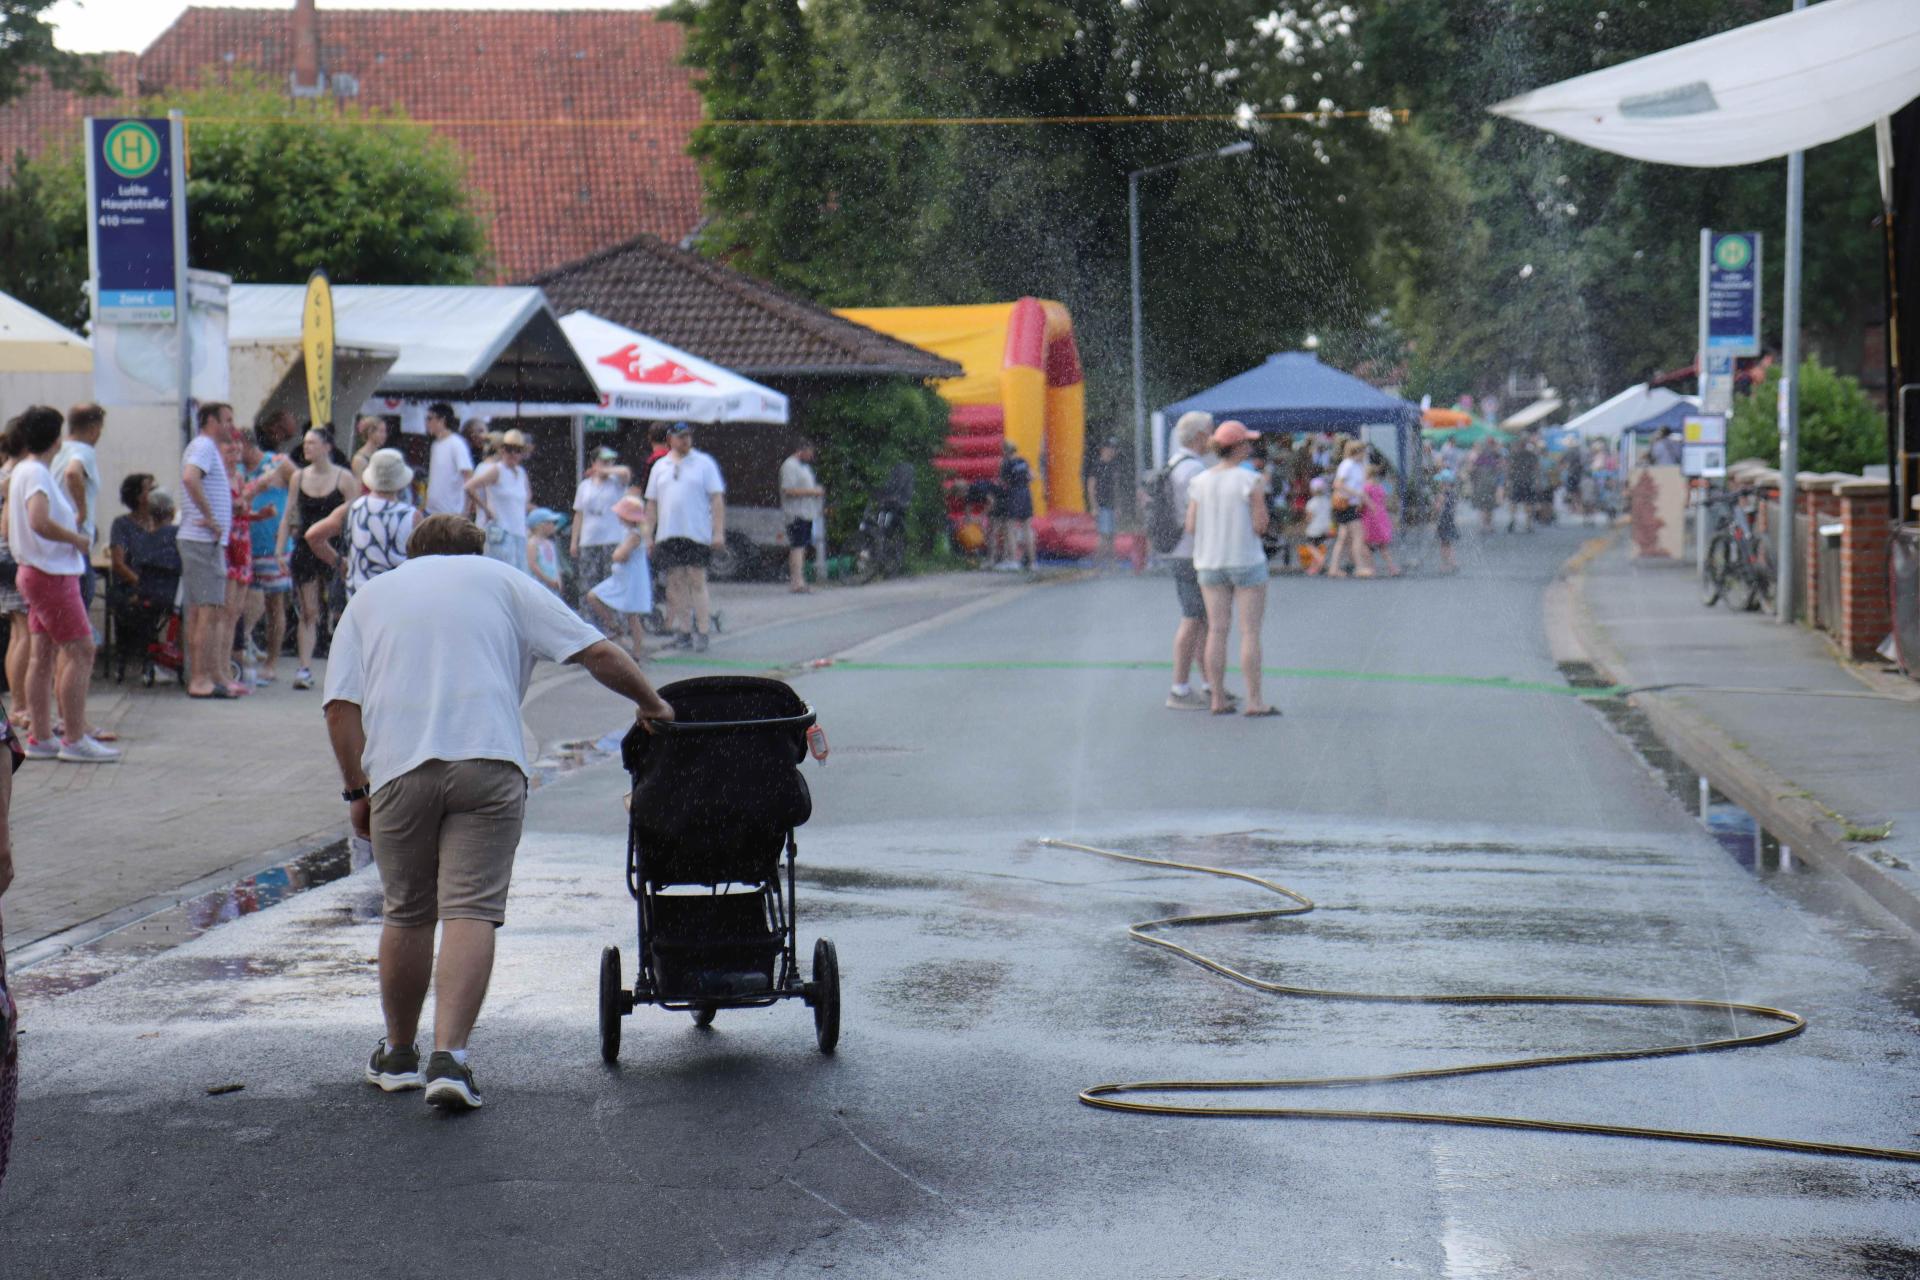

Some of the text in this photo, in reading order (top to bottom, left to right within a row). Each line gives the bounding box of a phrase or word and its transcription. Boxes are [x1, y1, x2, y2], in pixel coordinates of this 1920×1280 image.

[121, 136, 143, 163] H
[118, 184, 148, 196] Luthe
[101, 197, 166, 211] Hauptstraße
[99, 214, 120, 226] 410
